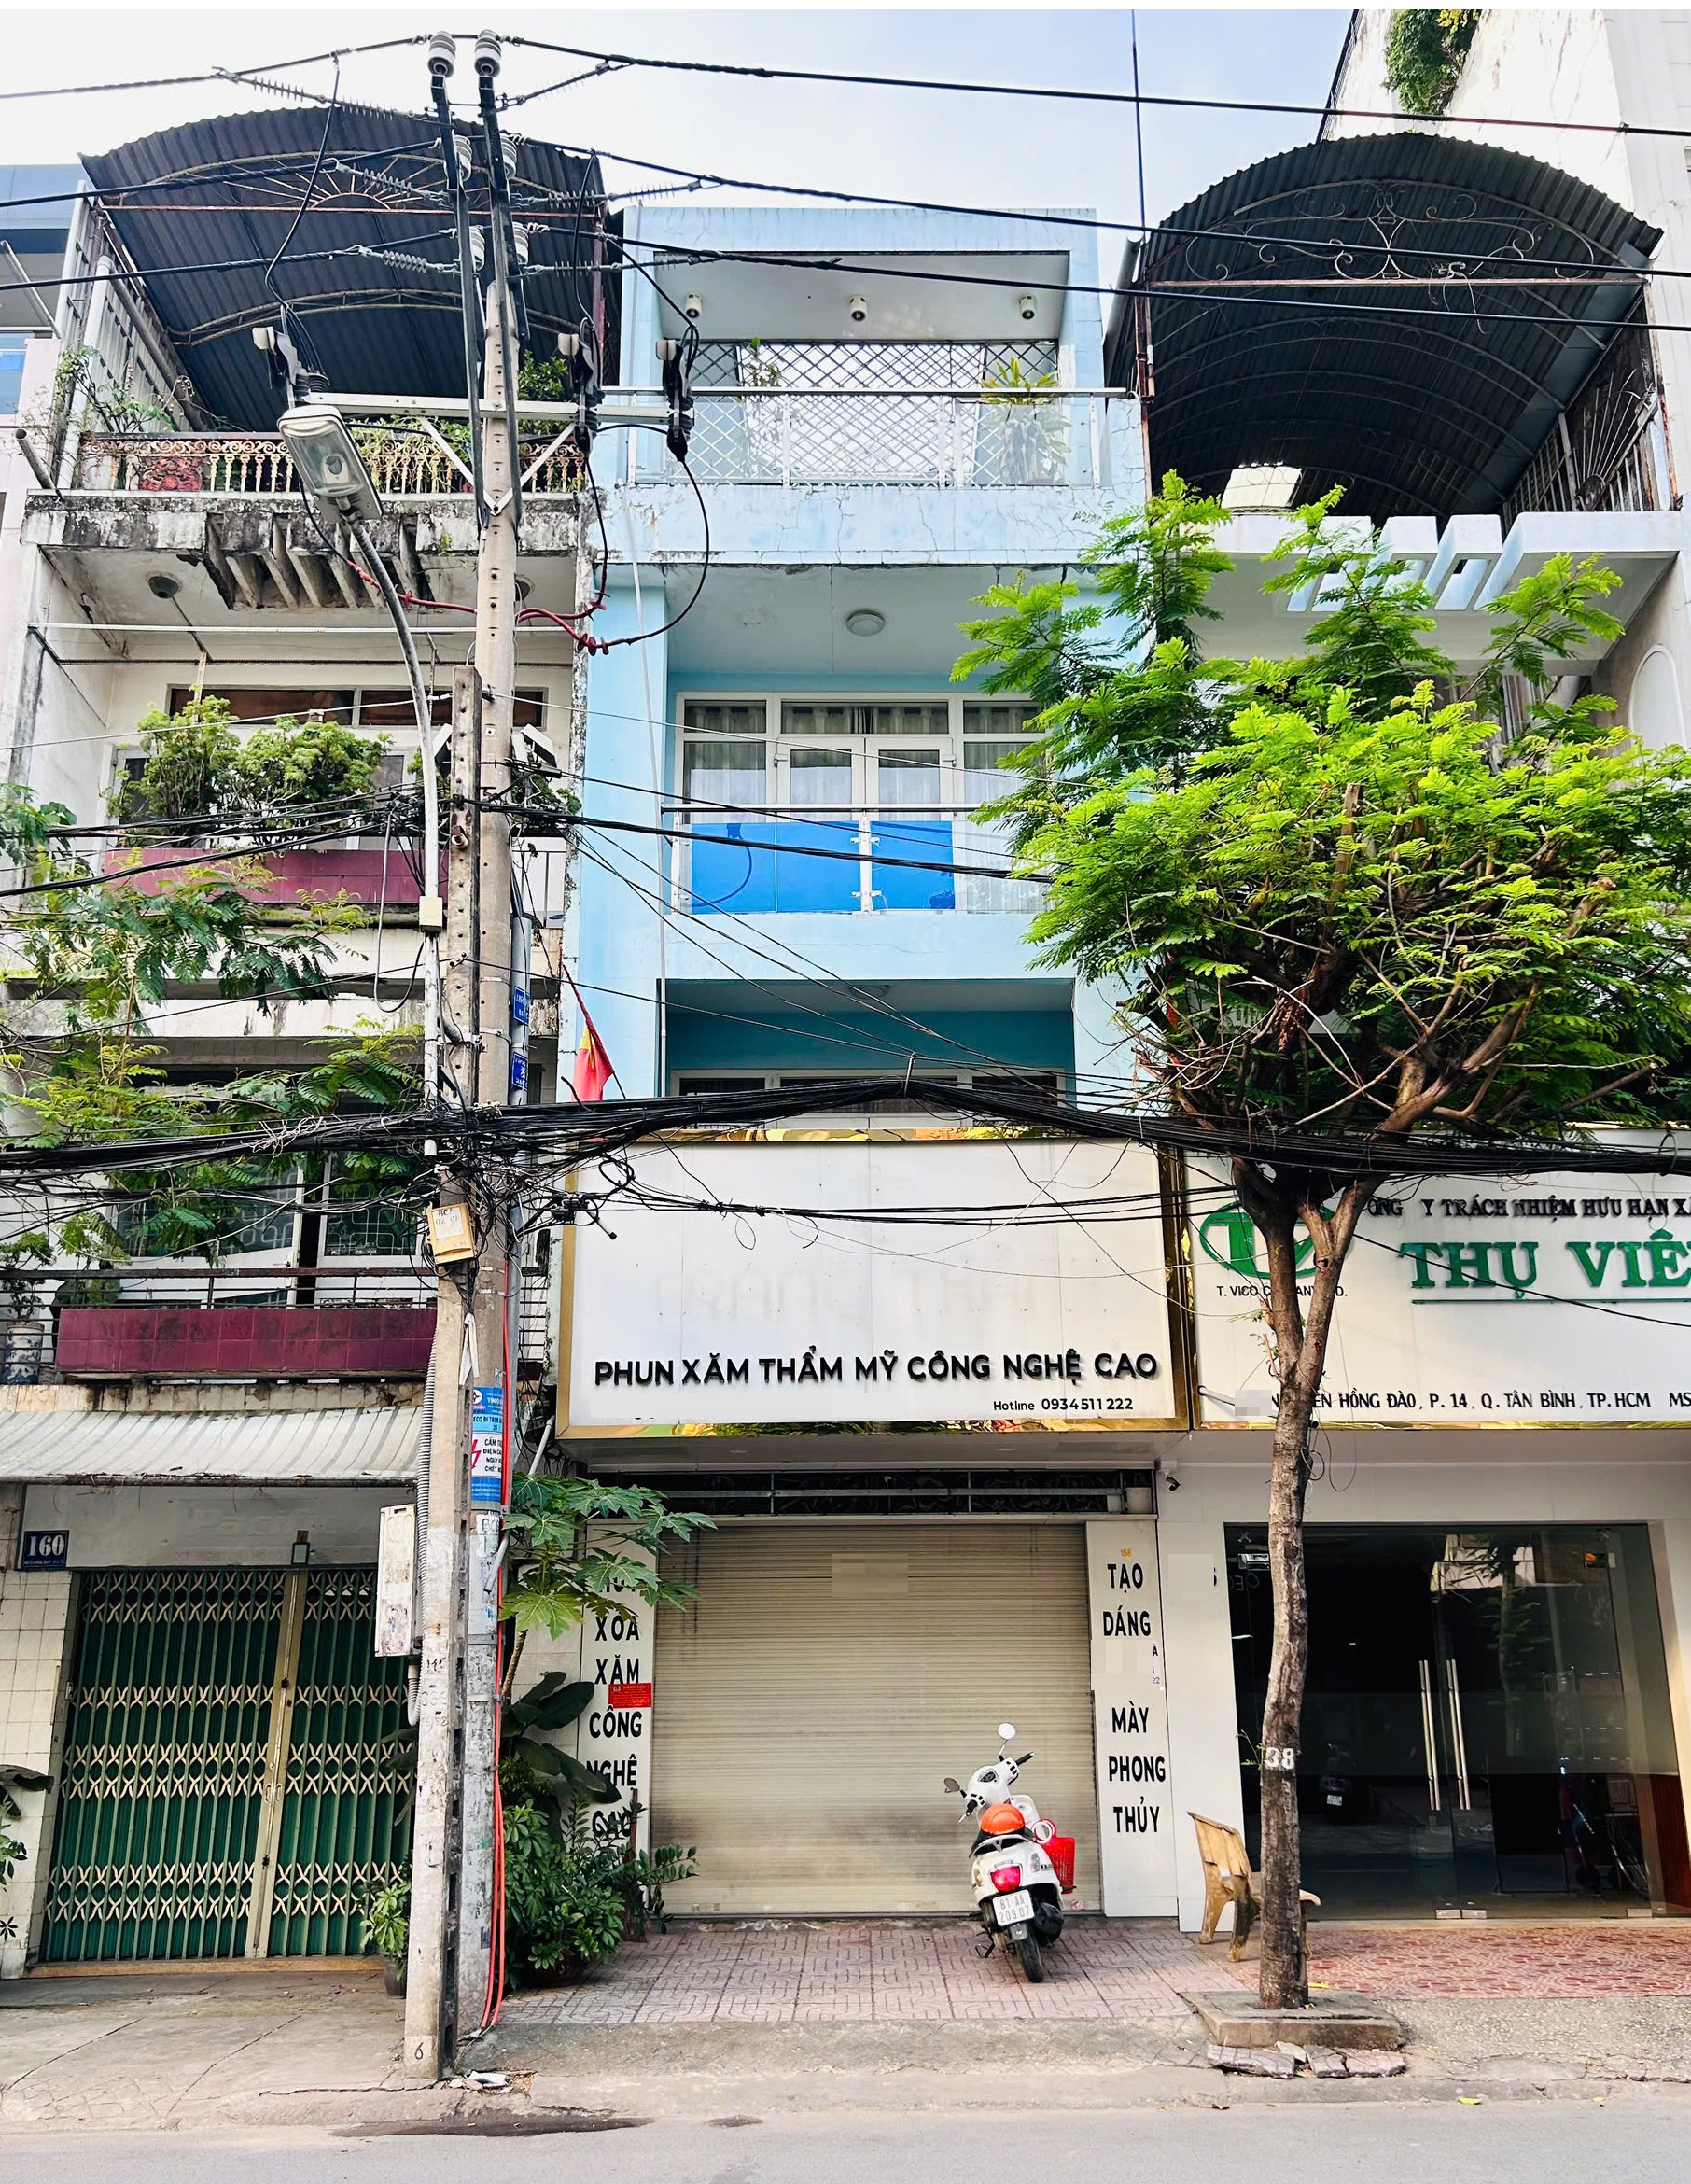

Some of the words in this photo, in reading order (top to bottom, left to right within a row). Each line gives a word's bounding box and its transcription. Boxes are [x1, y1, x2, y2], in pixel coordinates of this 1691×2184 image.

[1442, 1194, 1508, 1216] TRÁCH
[1512, 1195, 1578, 1223] NHIỆM
[1627, 1198, 1669, 1222] HẠN
[1672, 1197, 1691, 1217] X
[1398, 1241, 1539, 1300] THỤ
[1566, 1228, 1691, 1288] VIÊ
[594, 1360, 675, 1385] PHUN
[682, 1351, 749, 1384] XĂM
[759, 1345, 842, 1383] THẨM
[855, 1349, 898, 1381] MỸ
[907, 1349, 990, 1380] CÔNG
[1001, 1348, 1081, 1387] NGHỆ
[1094, 1352, 1157, 1380] CAO
[993, 1400, 1035, 1411] Hotline
[1339, 1387, 1381, 1407] HỒNG
[1504, 1390, 1533, 1407] TÂN
[28, 1535, 65, 1557] 160
[1107, 1562, 1143, 1593] TẠO
[1103, 1605, 1151, 1637] DÁNG
[594, 1654, 640, 1685] XĂM
[589, 1705, 642, 1739] CÔNG
[1111, 1701, 1149, 1733] MÀY
[586, 1753, 637, 1791] NGHỆ
[1109, 1755, 1166, 1782] PHONG
[1264, 1746, 1295, 1770] 38
[1113, 1795, 1160, 1833] THỦY
[414, 2041, 424, 2060] 6
